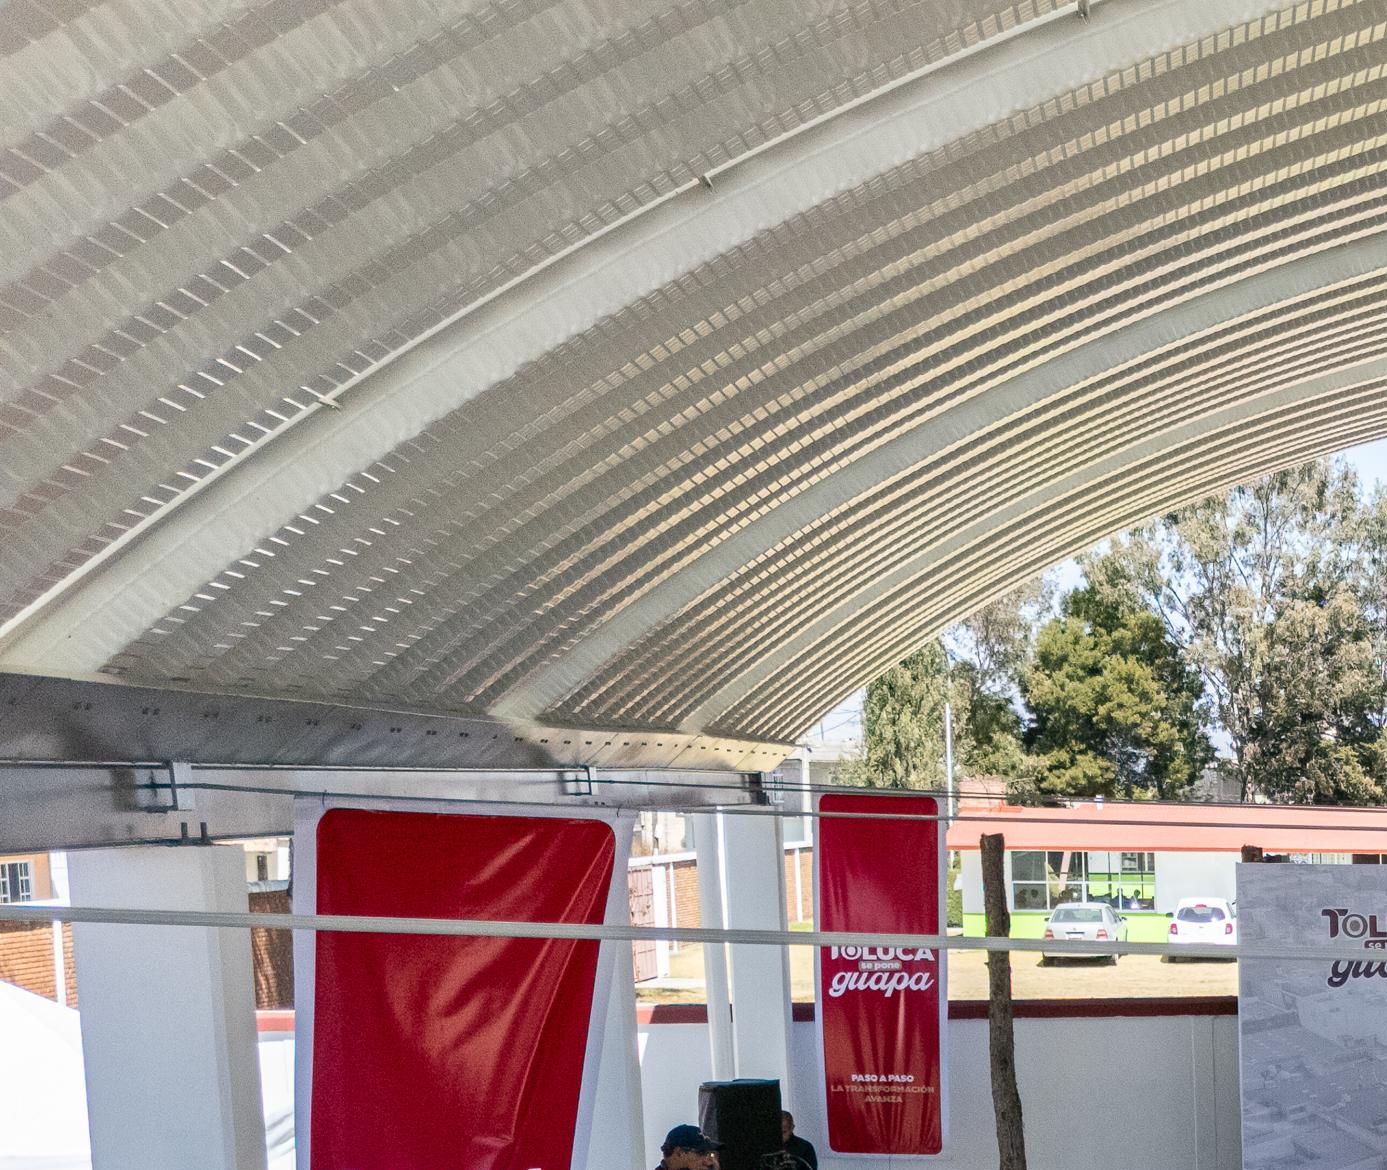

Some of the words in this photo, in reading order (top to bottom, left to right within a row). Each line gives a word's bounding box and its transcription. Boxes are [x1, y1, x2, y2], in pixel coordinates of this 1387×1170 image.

[1368, 942, 1382, 950] se
[860, 961, 873, 969] se
[874, 961, 900, 971] pone
[828, 971, 935, 998] guapa
[851, 1074, 878, 1082] PASO
[879, 1074, 888, 1082] A
[888, 1074, 914, 1083] PASO
[844, 1084, 935, 1093] TRANSFORMACIÓN
[864, 1095, 903, 1103] AVANZA
